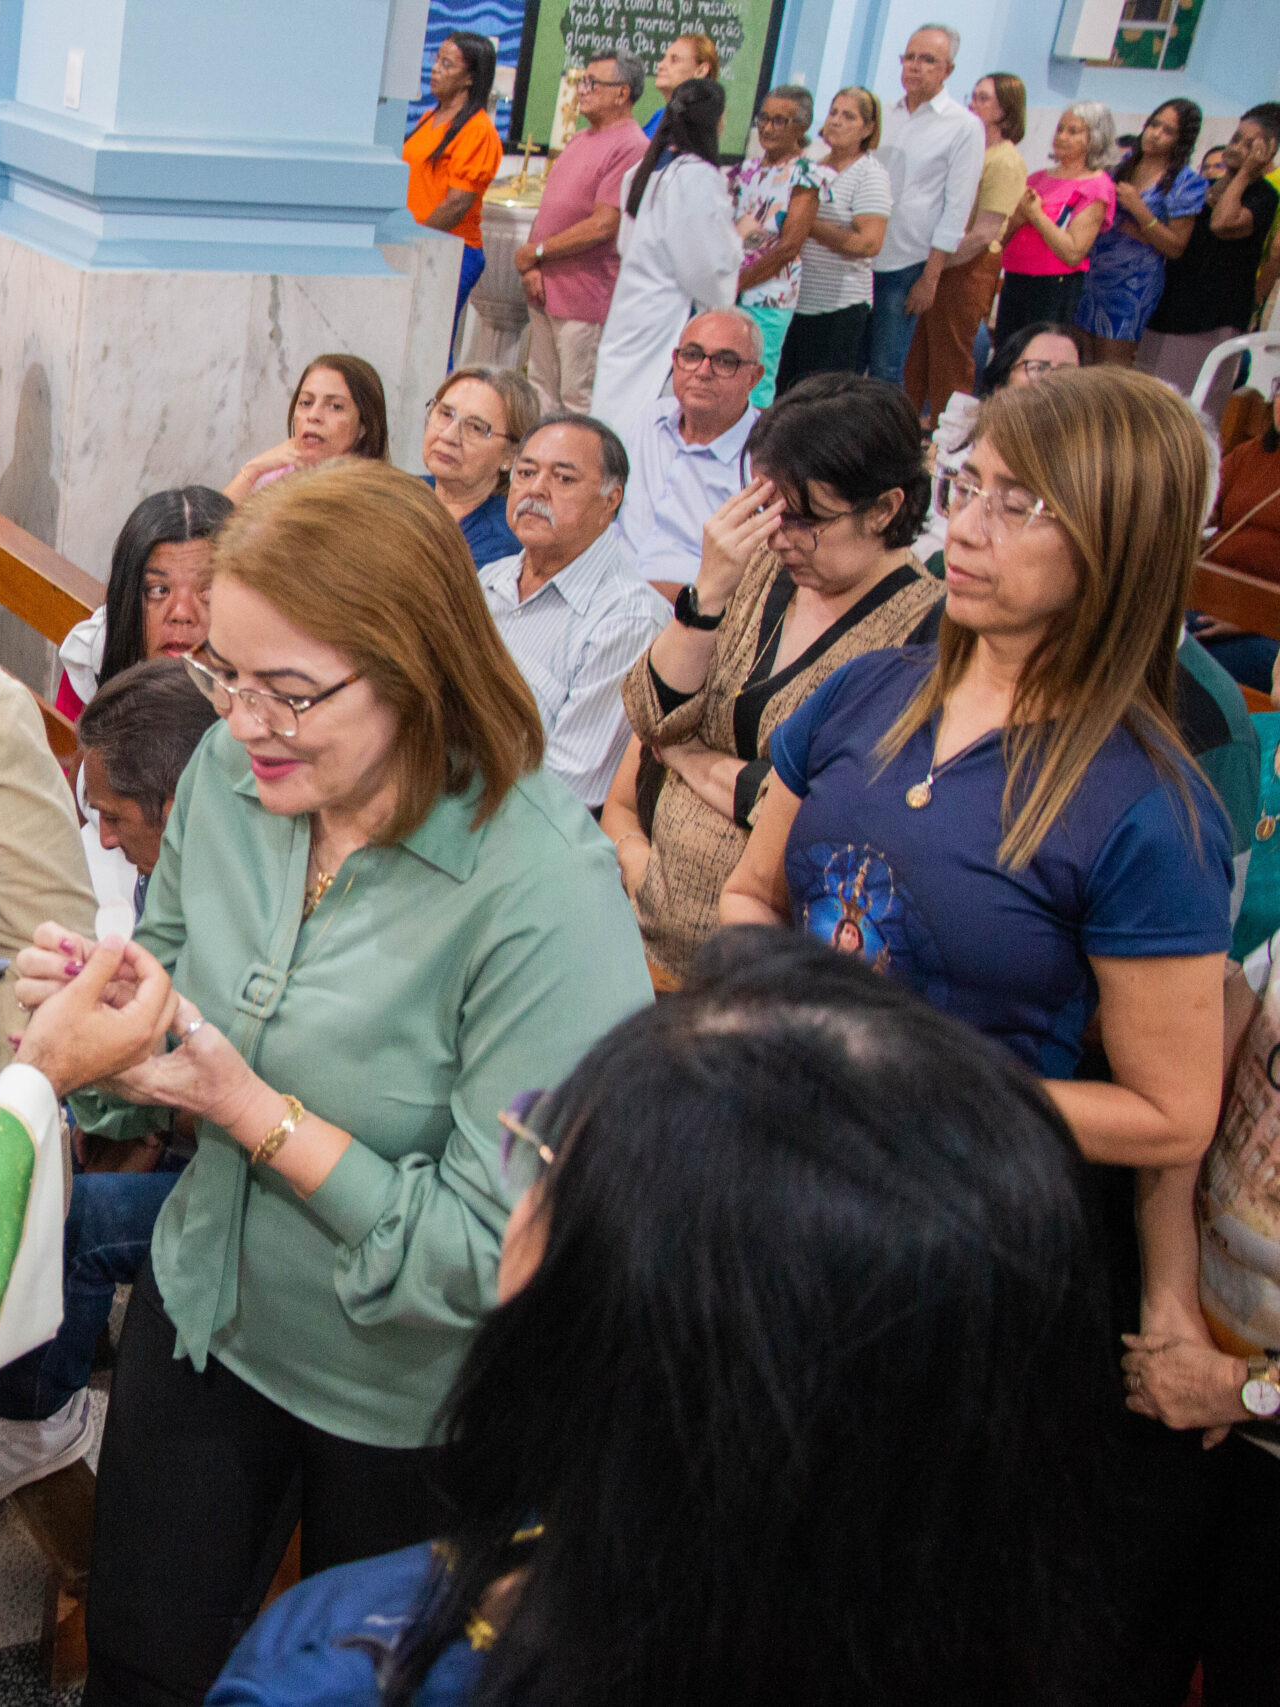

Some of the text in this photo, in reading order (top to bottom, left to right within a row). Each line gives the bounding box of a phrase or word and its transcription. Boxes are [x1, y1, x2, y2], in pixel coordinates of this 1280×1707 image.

[565, 25, 613, 53] gloriosa
[634, 17, 675, 35] mortos
[681, 17, 705, 35] pela
[711, 20, 741, 40] ação
